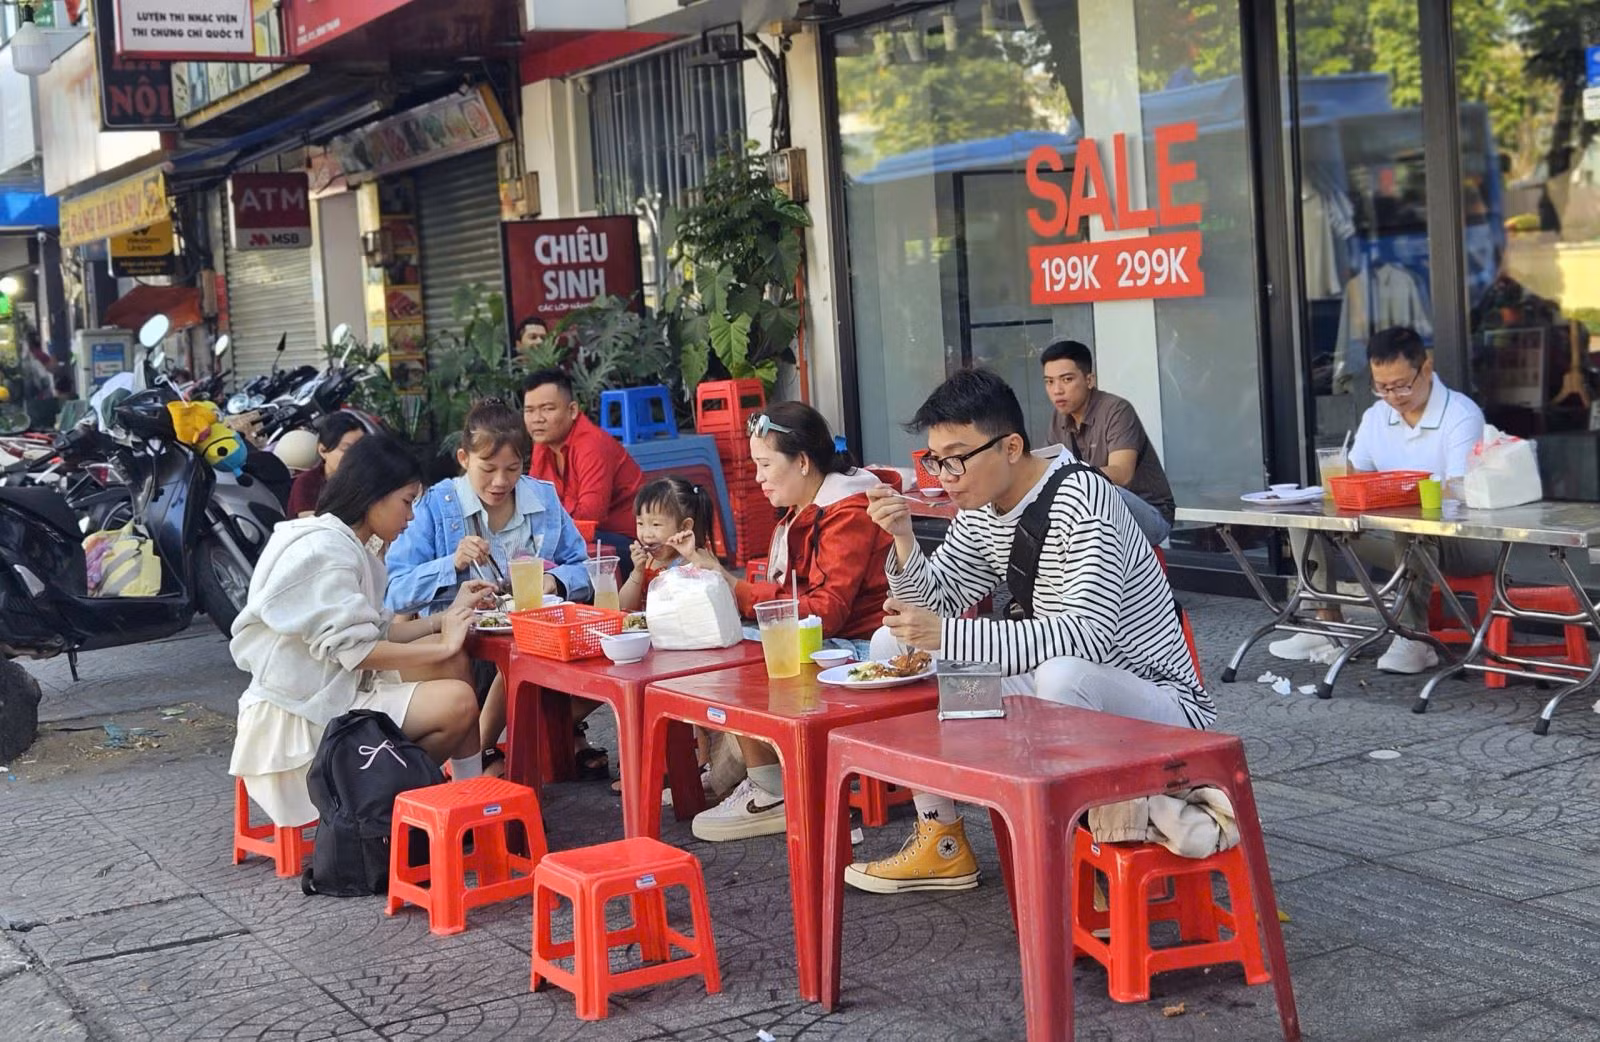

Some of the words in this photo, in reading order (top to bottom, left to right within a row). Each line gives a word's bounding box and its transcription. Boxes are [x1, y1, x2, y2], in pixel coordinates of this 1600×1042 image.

[169, 13, 185, 22] THI
[131, 28, 148, 37] THI
[1025, 120, 1202, 238] SALE
[240, 187, 305, 212] ATM
[271, 233, 300, 245] MSB
[534, 225, 609, 266] CHIÊU
[1041, 255, 1101, 292] 199K
[1116, 246, 1190, 288] 299K
[542, 267, 607, 301] SINH
